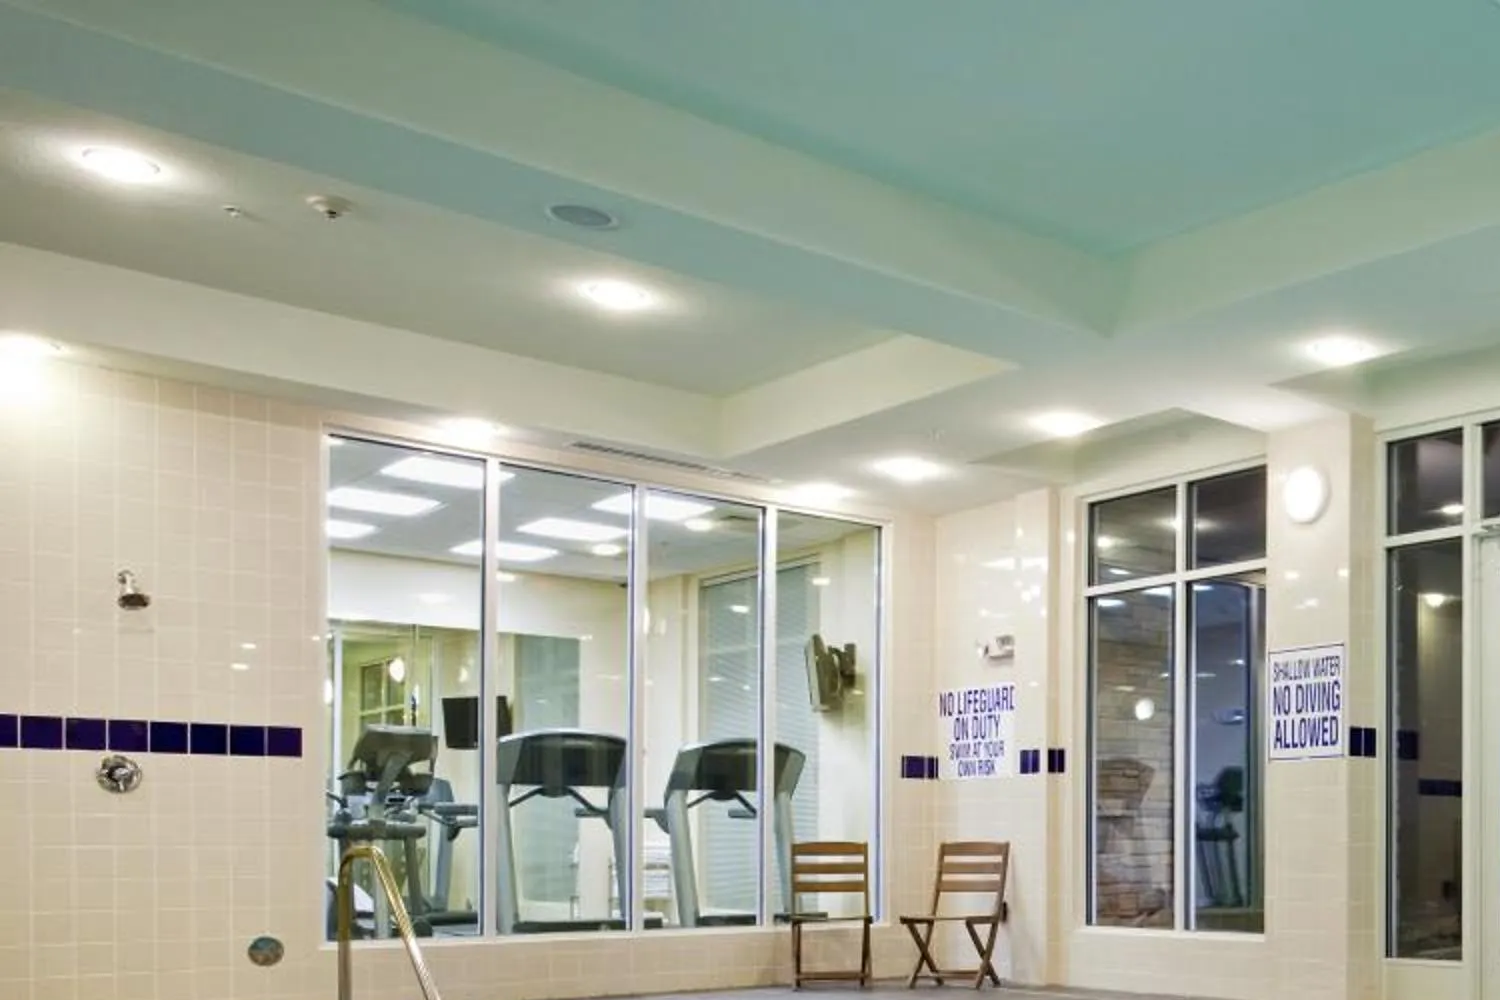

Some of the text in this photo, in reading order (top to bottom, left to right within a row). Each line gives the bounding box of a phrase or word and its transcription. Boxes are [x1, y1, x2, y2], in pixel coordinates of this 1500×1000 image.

[1273, 656, 1340, 682] SHALLOW WATER
[939, 692, 954, 716] NO
[1273, 680, 1340, 716] NO DIVING
[954, 714, 1000, 741] ON DUTY
[1274, 716, 1339, 749] ALLOWED
[973, 741, 981, 758] AT
